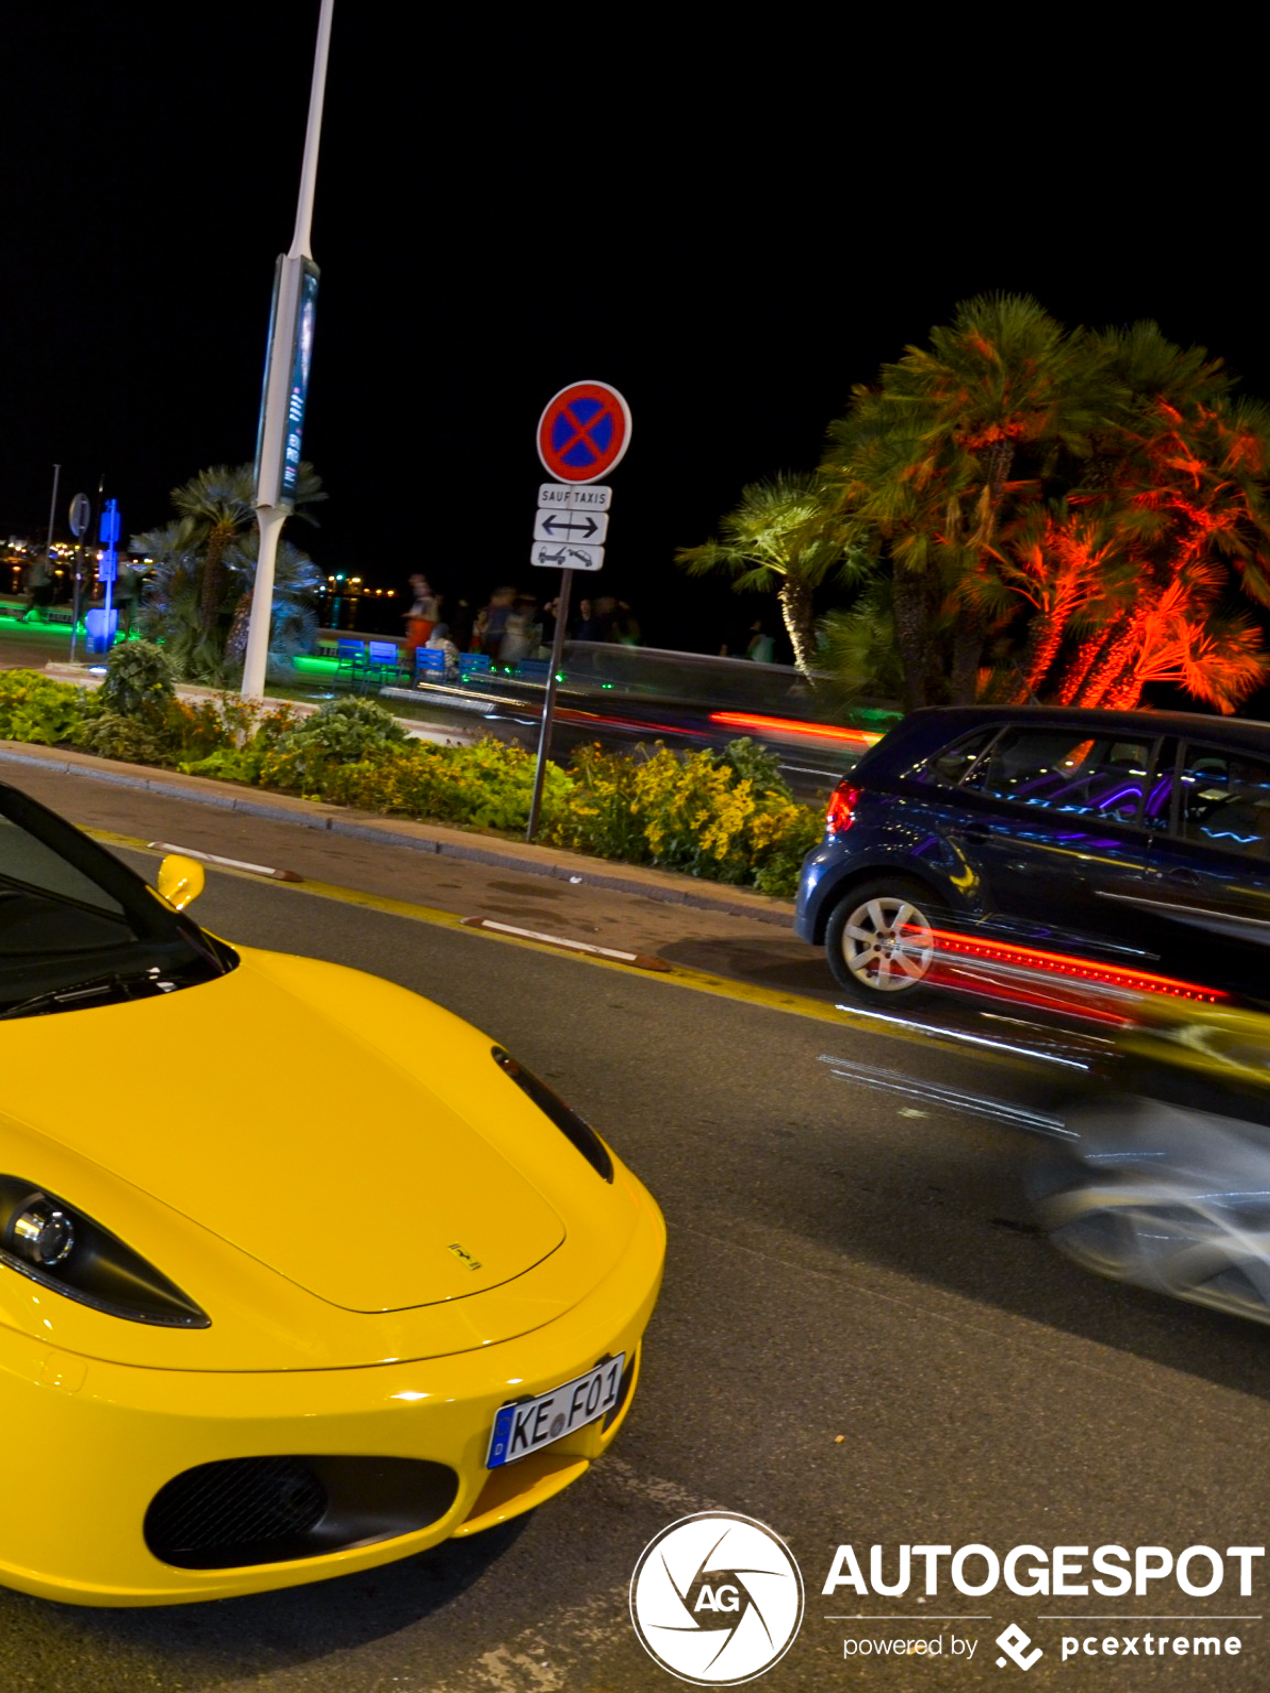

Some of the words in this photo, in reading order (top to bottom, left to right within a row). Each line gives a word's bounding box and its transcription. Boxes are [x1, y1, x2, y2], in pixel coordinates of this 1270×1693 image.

[542, 491, 570, 502] SAUF
[574, 493, 607, 505] TAXIS
[510, 1399, 554, 1454] KE
